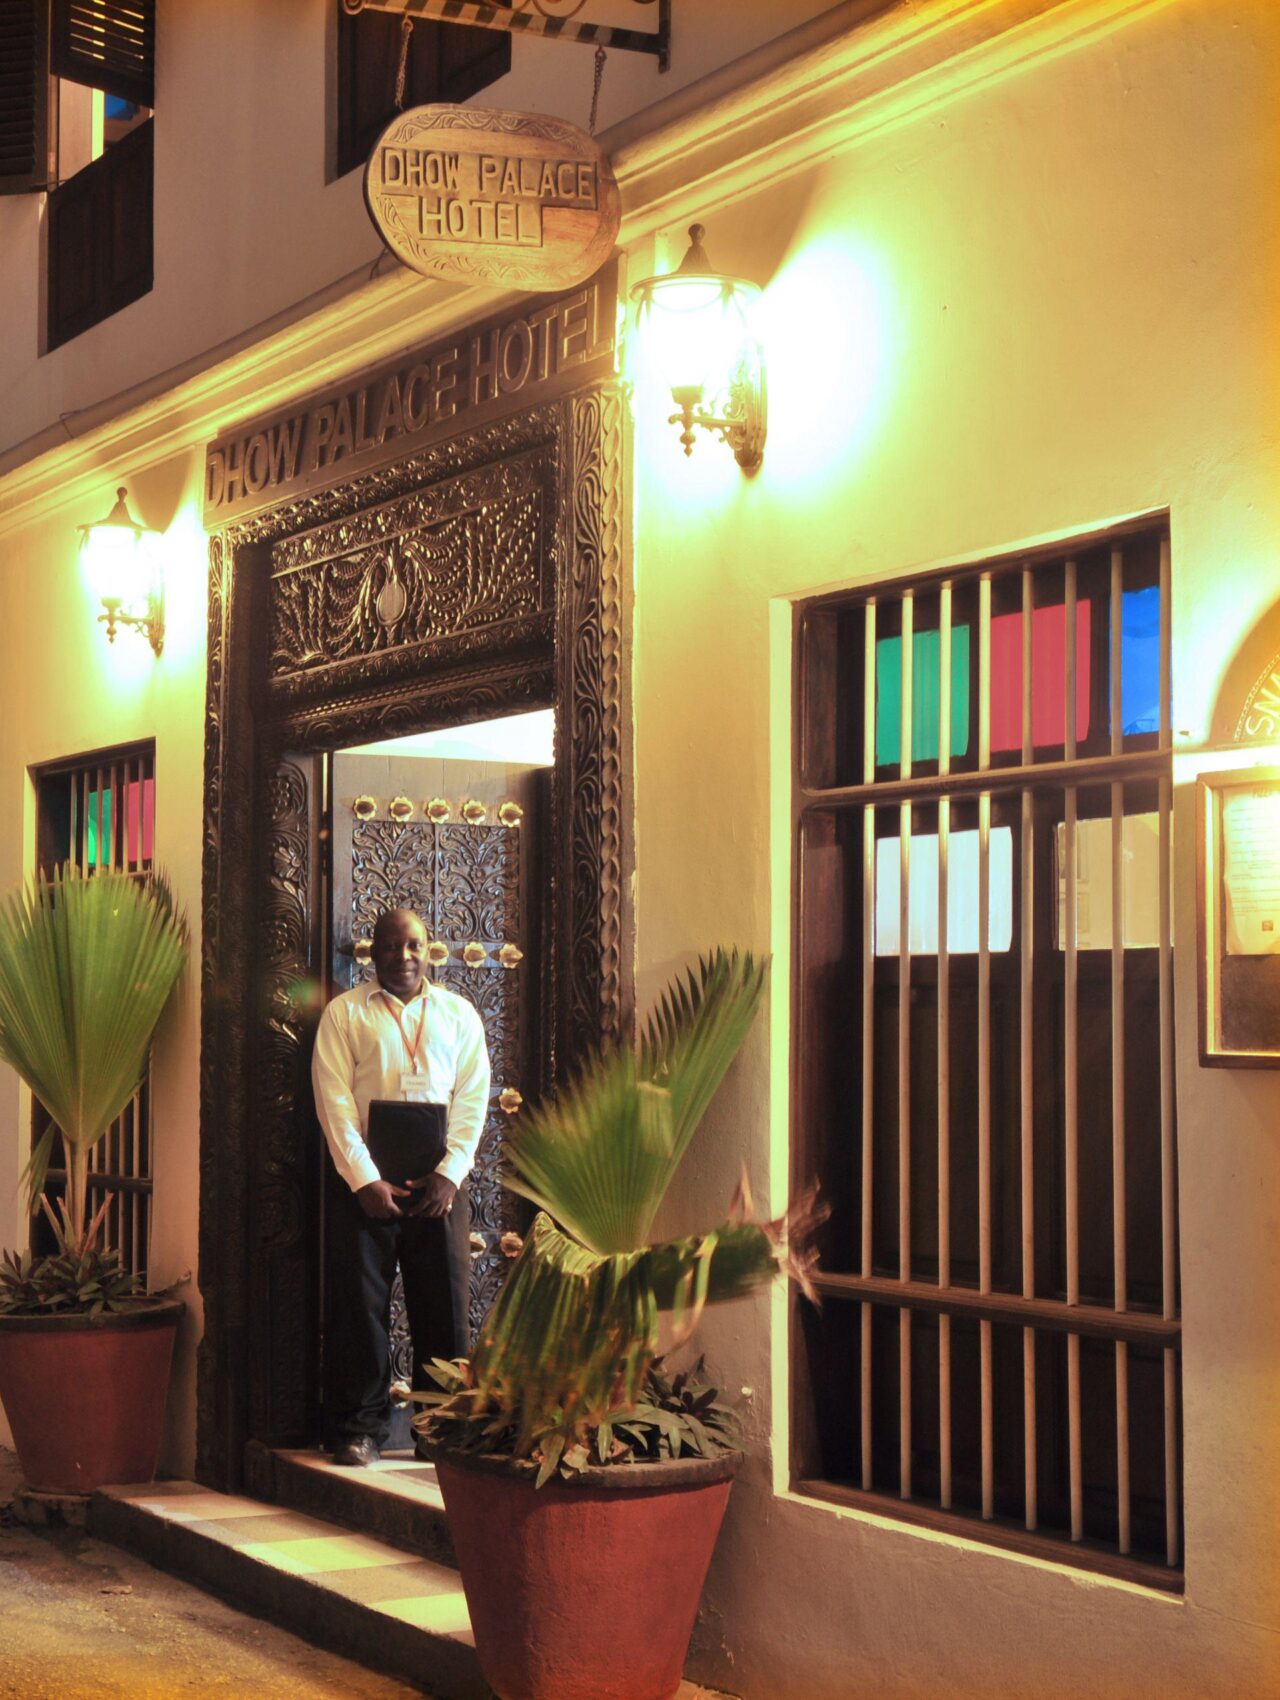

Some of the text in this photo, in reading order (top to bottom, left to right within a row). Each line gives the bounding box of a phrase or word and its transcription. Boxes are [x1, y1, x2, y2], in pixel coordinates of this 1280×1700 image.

[383, 148, 594, 200] DHOW PALACE
[419, 196, 539, 241] HOTEL
[207, 285, 615, 509] DHOW PALACE HOTEL
